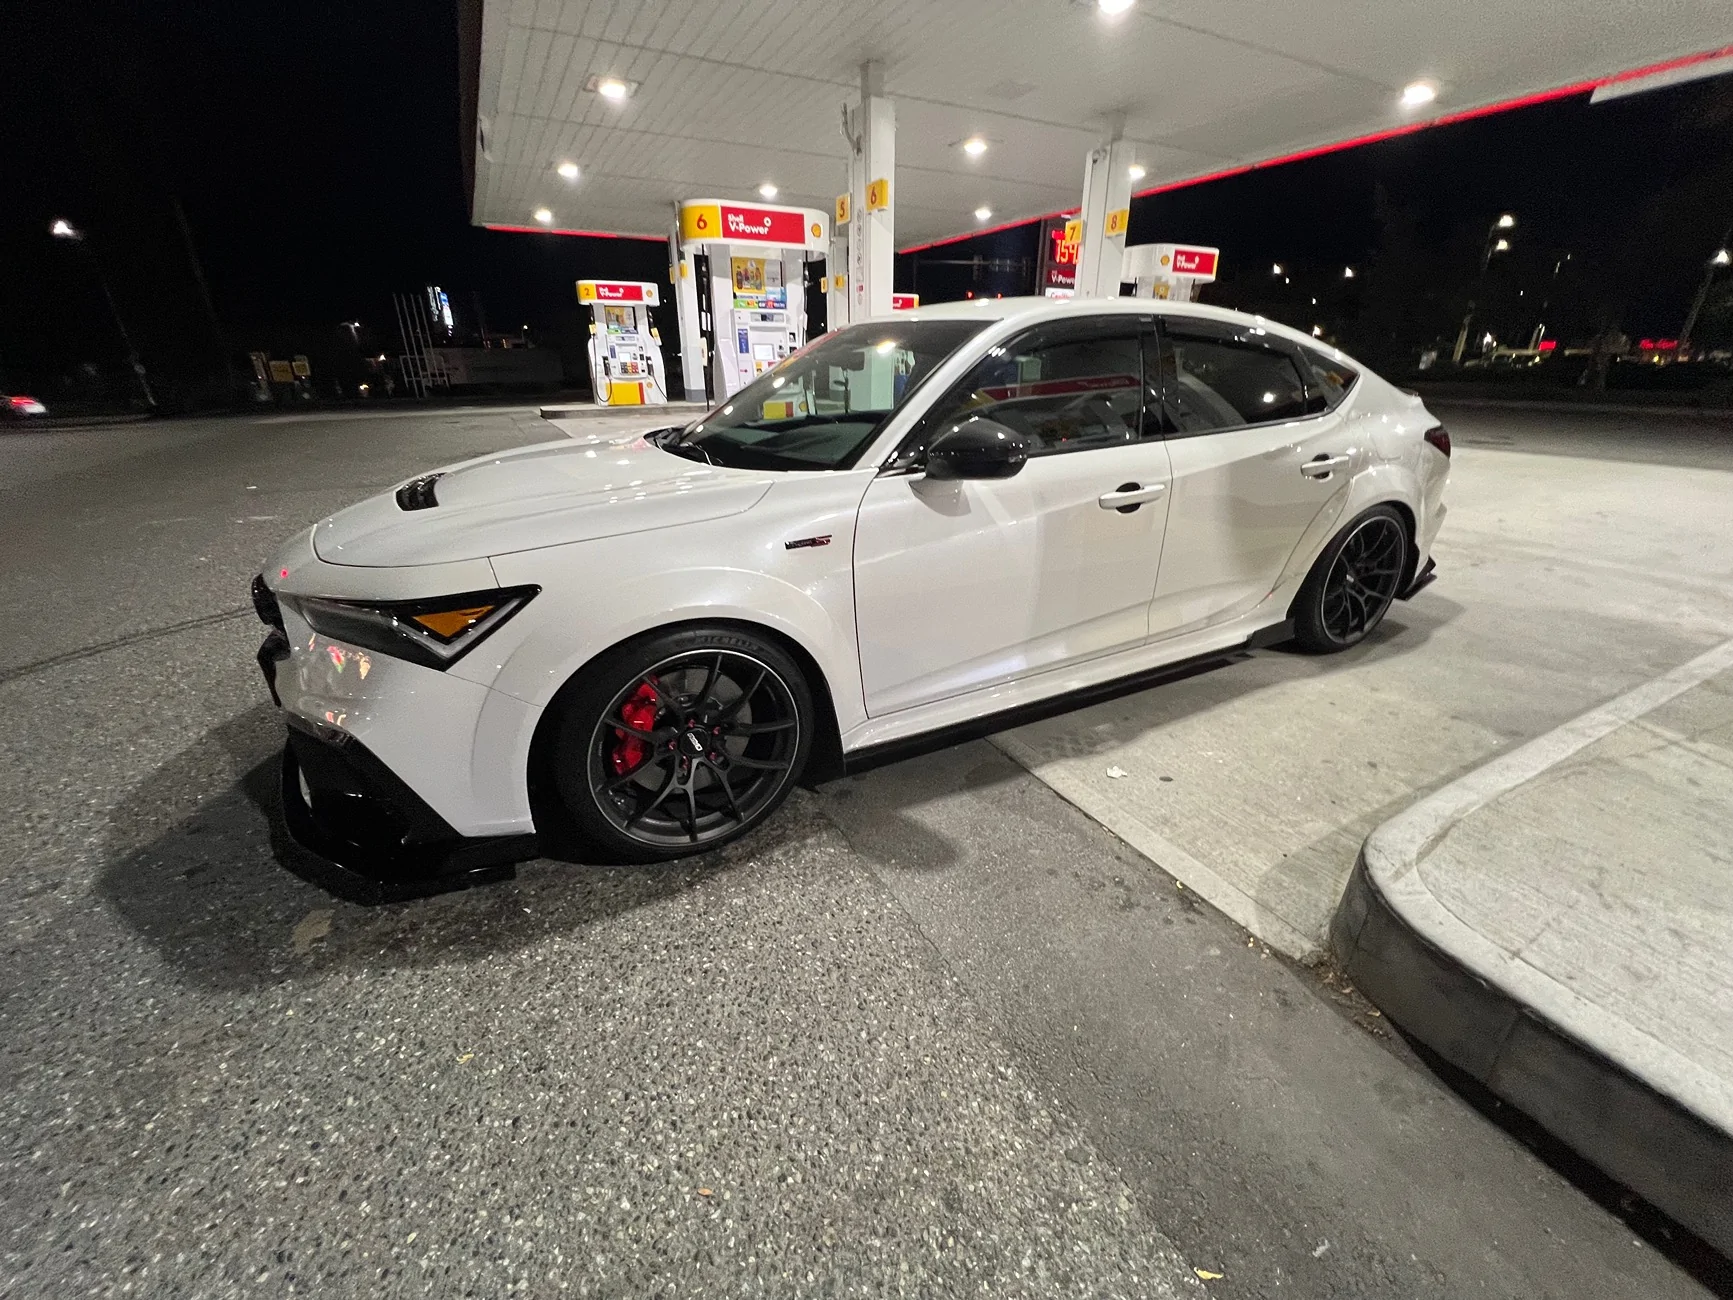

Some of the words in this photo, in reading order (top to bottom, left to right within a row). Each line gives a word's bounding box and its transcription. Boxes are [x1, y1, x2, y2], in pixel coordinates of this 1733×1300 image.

[870, 185, 877, 206] 6
[840, 201, 845, 218] 5
[697, 213, 708, 230] 6
[727, 213, 744, 224] Shell
[1111, 215, 1117, 232] 8
[728, 222, 769, 235] V-Power
[1070, 226, 1077, 241] 7
[584, 287, 590, 296] 2
